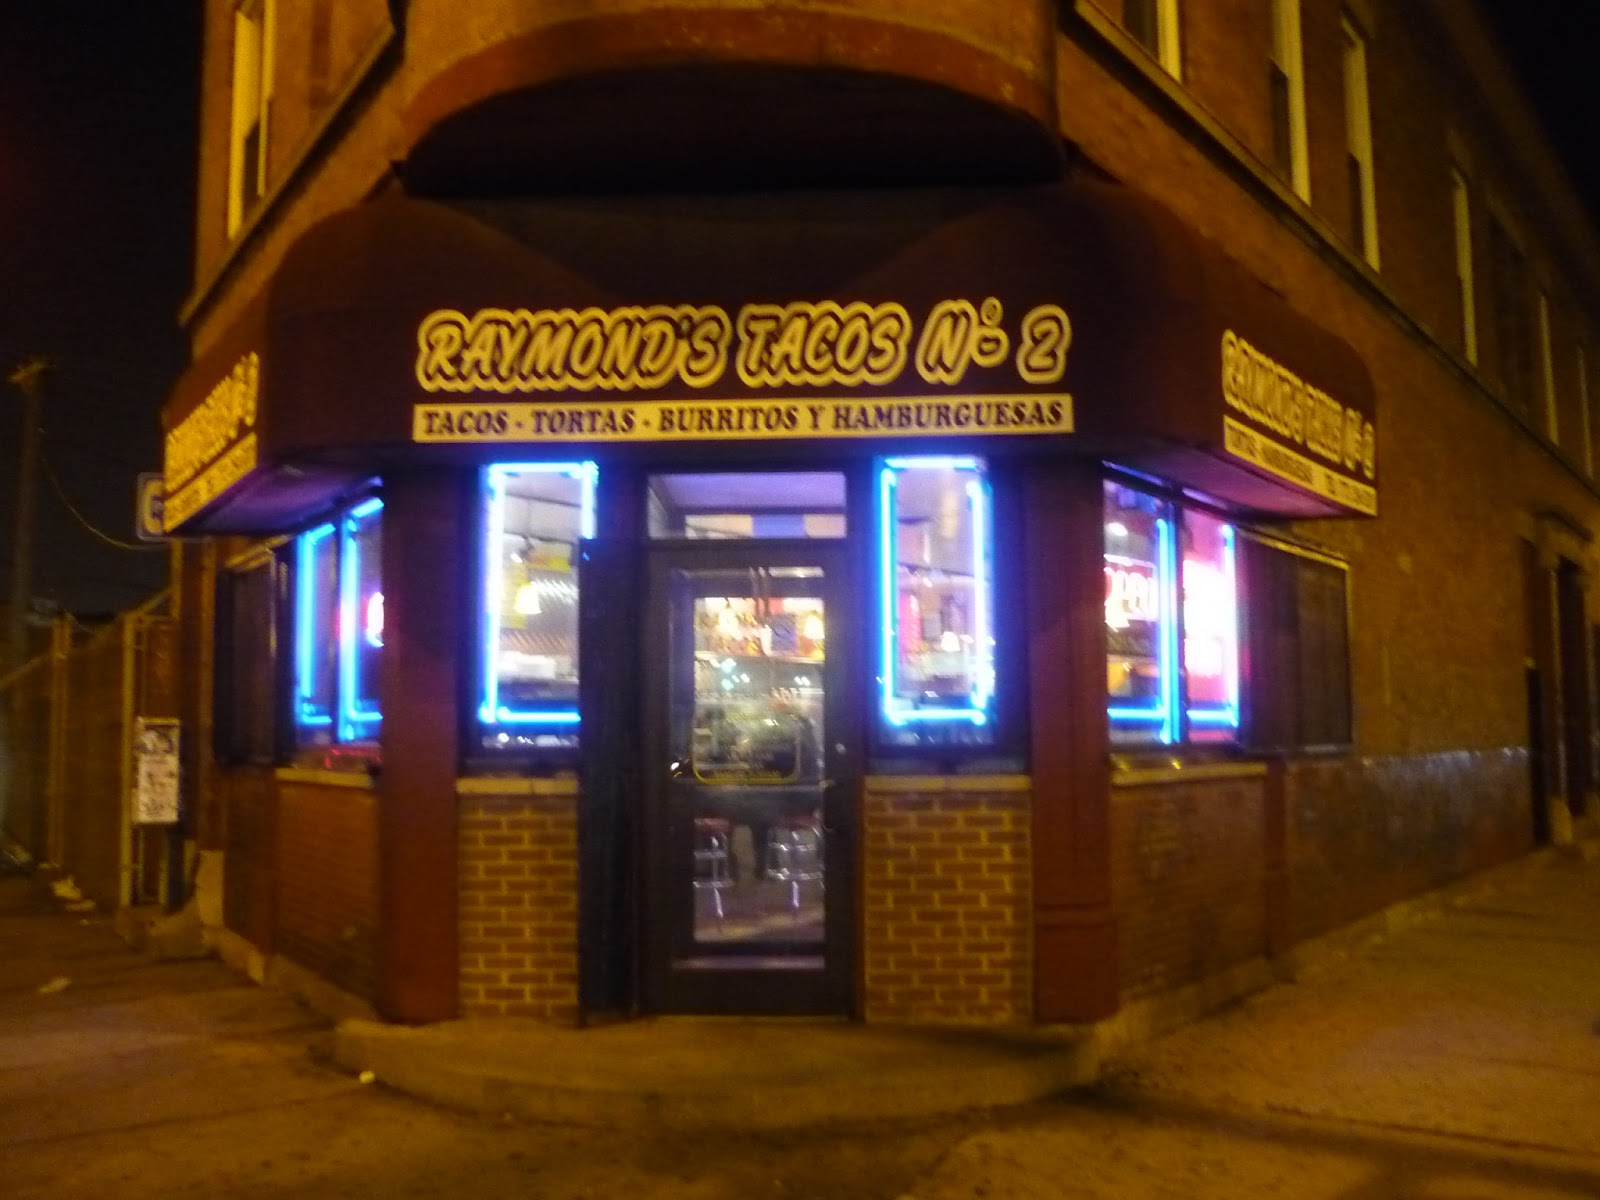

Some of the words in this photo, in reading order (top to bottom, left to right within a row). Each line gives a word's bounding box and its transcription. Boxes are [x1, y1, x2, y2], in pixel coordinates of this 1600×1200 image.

[415, 304, 732, 393] RAYMOND'S
[735, 300, 912, 388] TACOS
[1016, 304, 1072, 384] 2
[424, 410, 508, 435] TACOS
[532, 409, 636, 434] TORTAS
[657, 404, 799, 432] BURRITOS
[807, 404, 824, 429] Y
[834, 400, 1064, 430] HAMBURGUESAS
